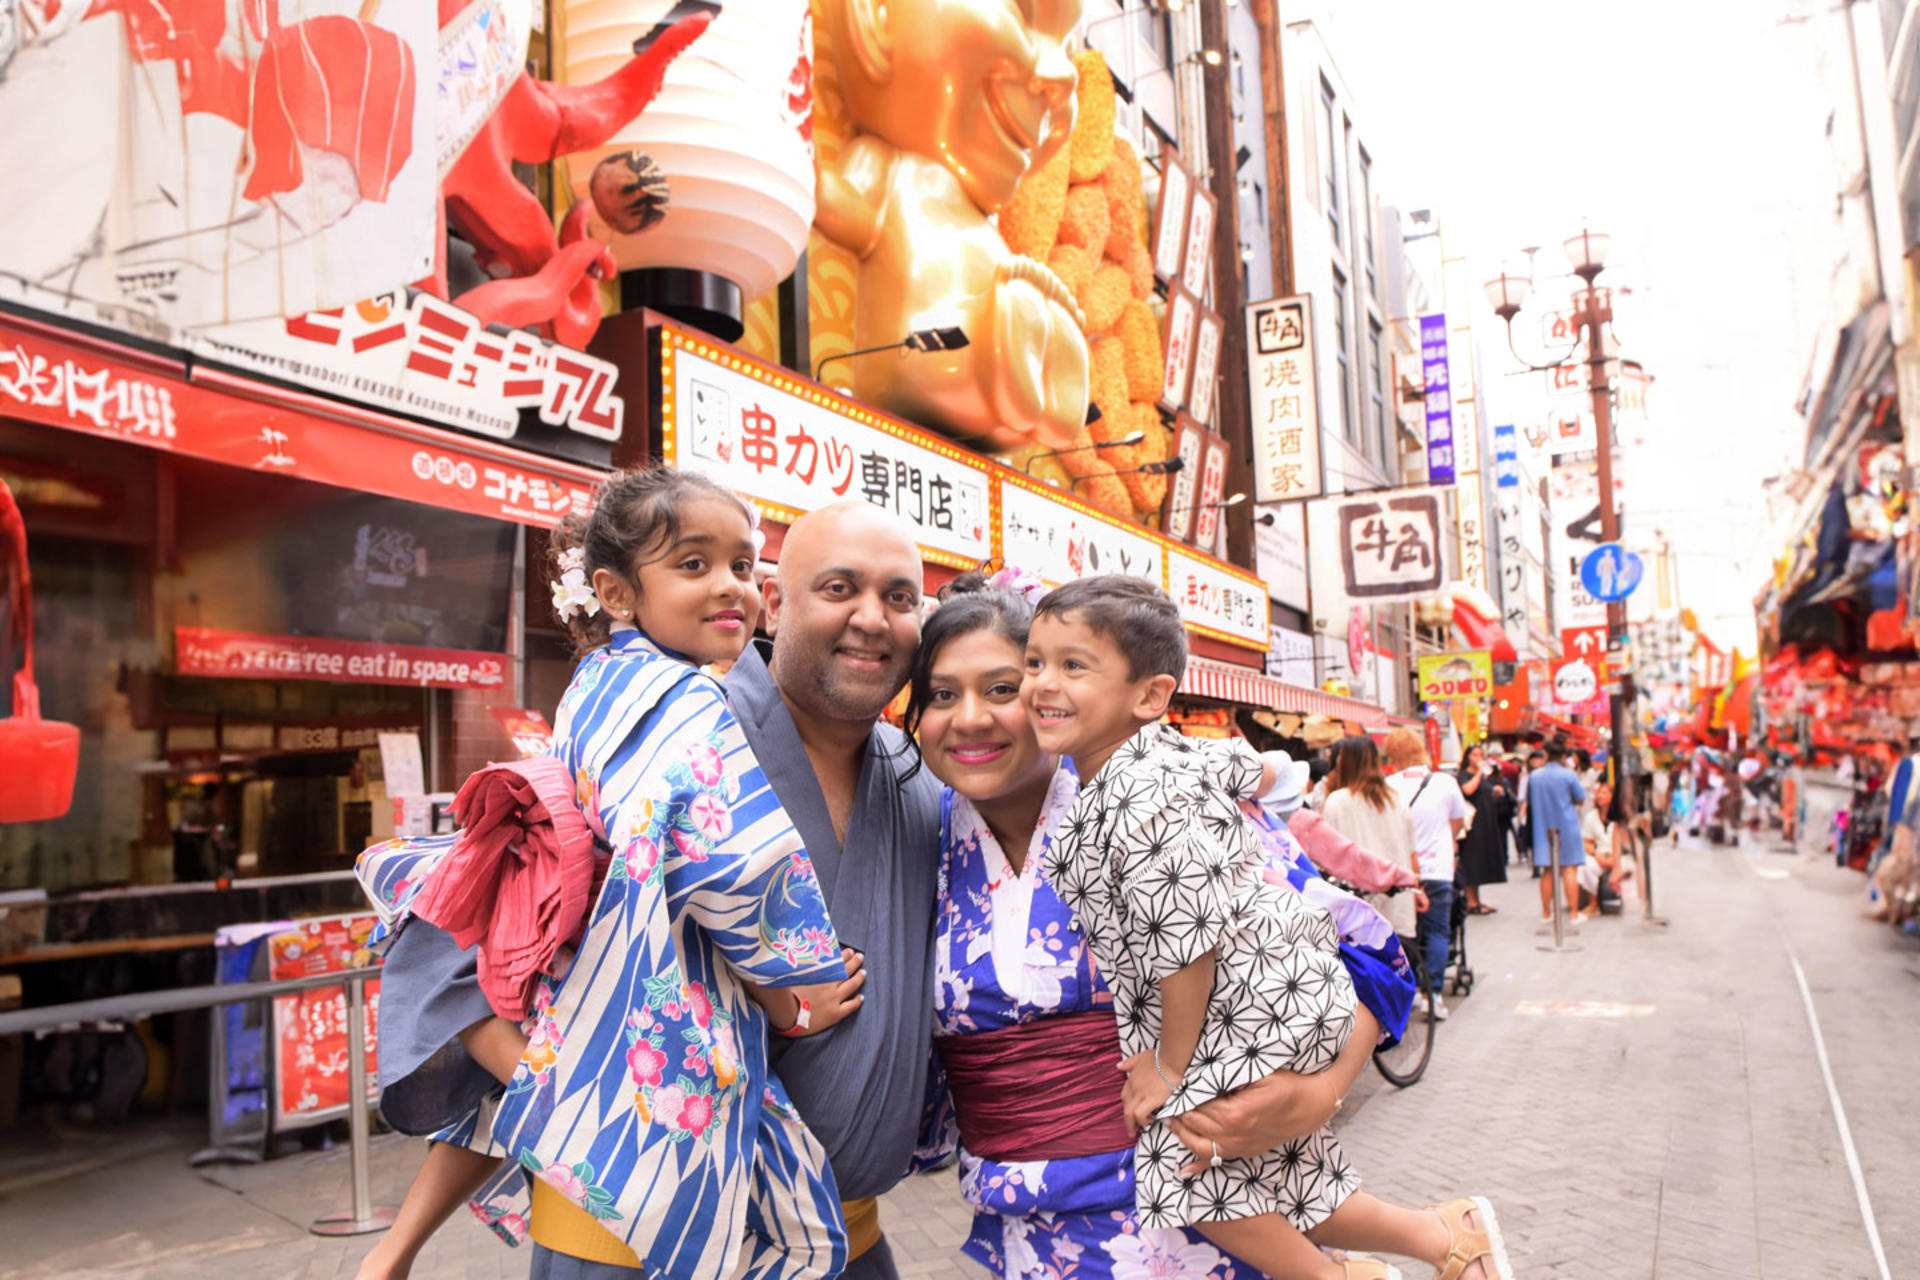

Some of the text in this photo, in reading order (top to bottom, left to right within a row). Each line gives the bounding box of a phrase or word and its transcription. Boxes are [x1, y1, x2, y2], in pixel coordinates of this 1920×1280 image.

[1262, 315, 1299, 341] 牛角
[1355, 519, 1431, 572] 牛角
[347, 653, 385, 678] eat
[387, 656, 410, 678] in
[411, 662, 470, 687] space
